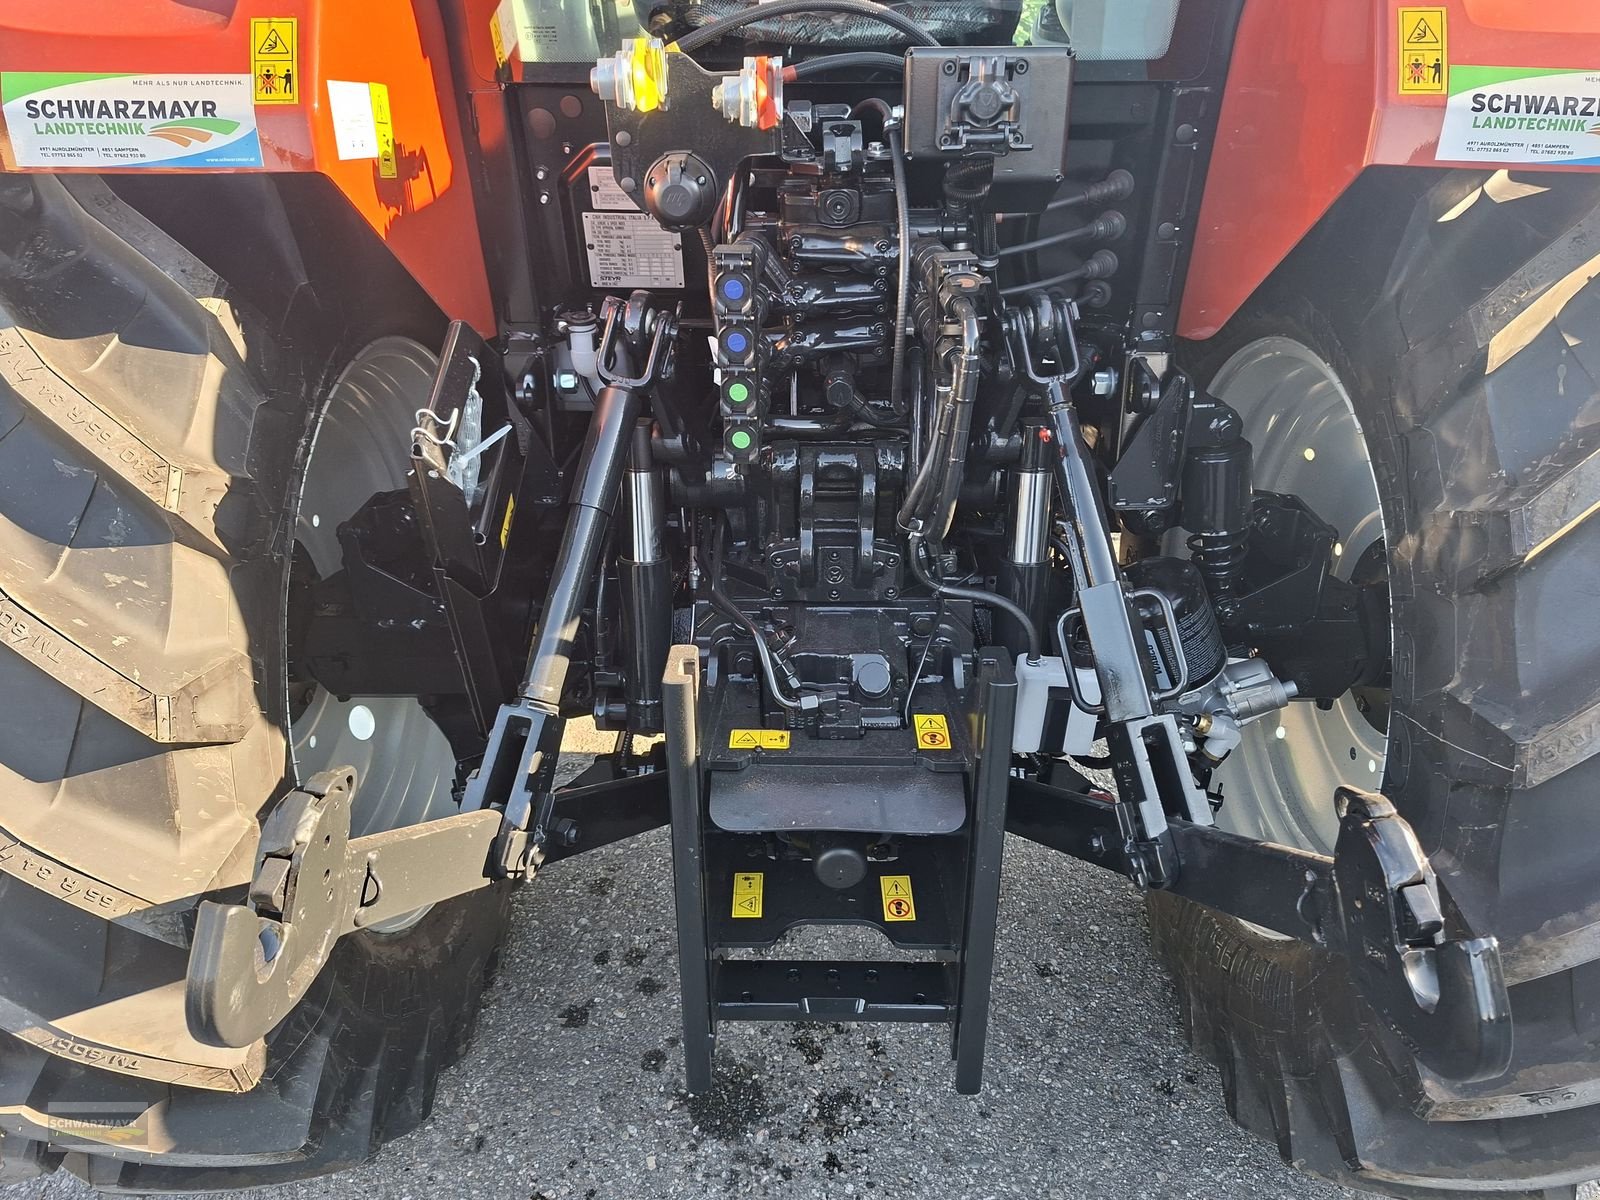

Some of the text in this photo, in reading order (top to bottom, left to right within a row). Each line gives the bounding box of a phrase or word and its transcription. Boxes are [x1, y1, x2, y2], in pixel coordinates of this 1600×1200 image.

[132, 79, 154, 87] MEHR
[156, 79, 170, 87] ALS
[172, 79, 188, 87] NUR
[25, 99, 217, 119] SCHWARZMAYR
[1471, 93, 1600, 116] SCHWARZ
[34, 122, 146, 135] LANDTECHNIK
[1472, 116, 1588, 132] LANDTECHNIK
